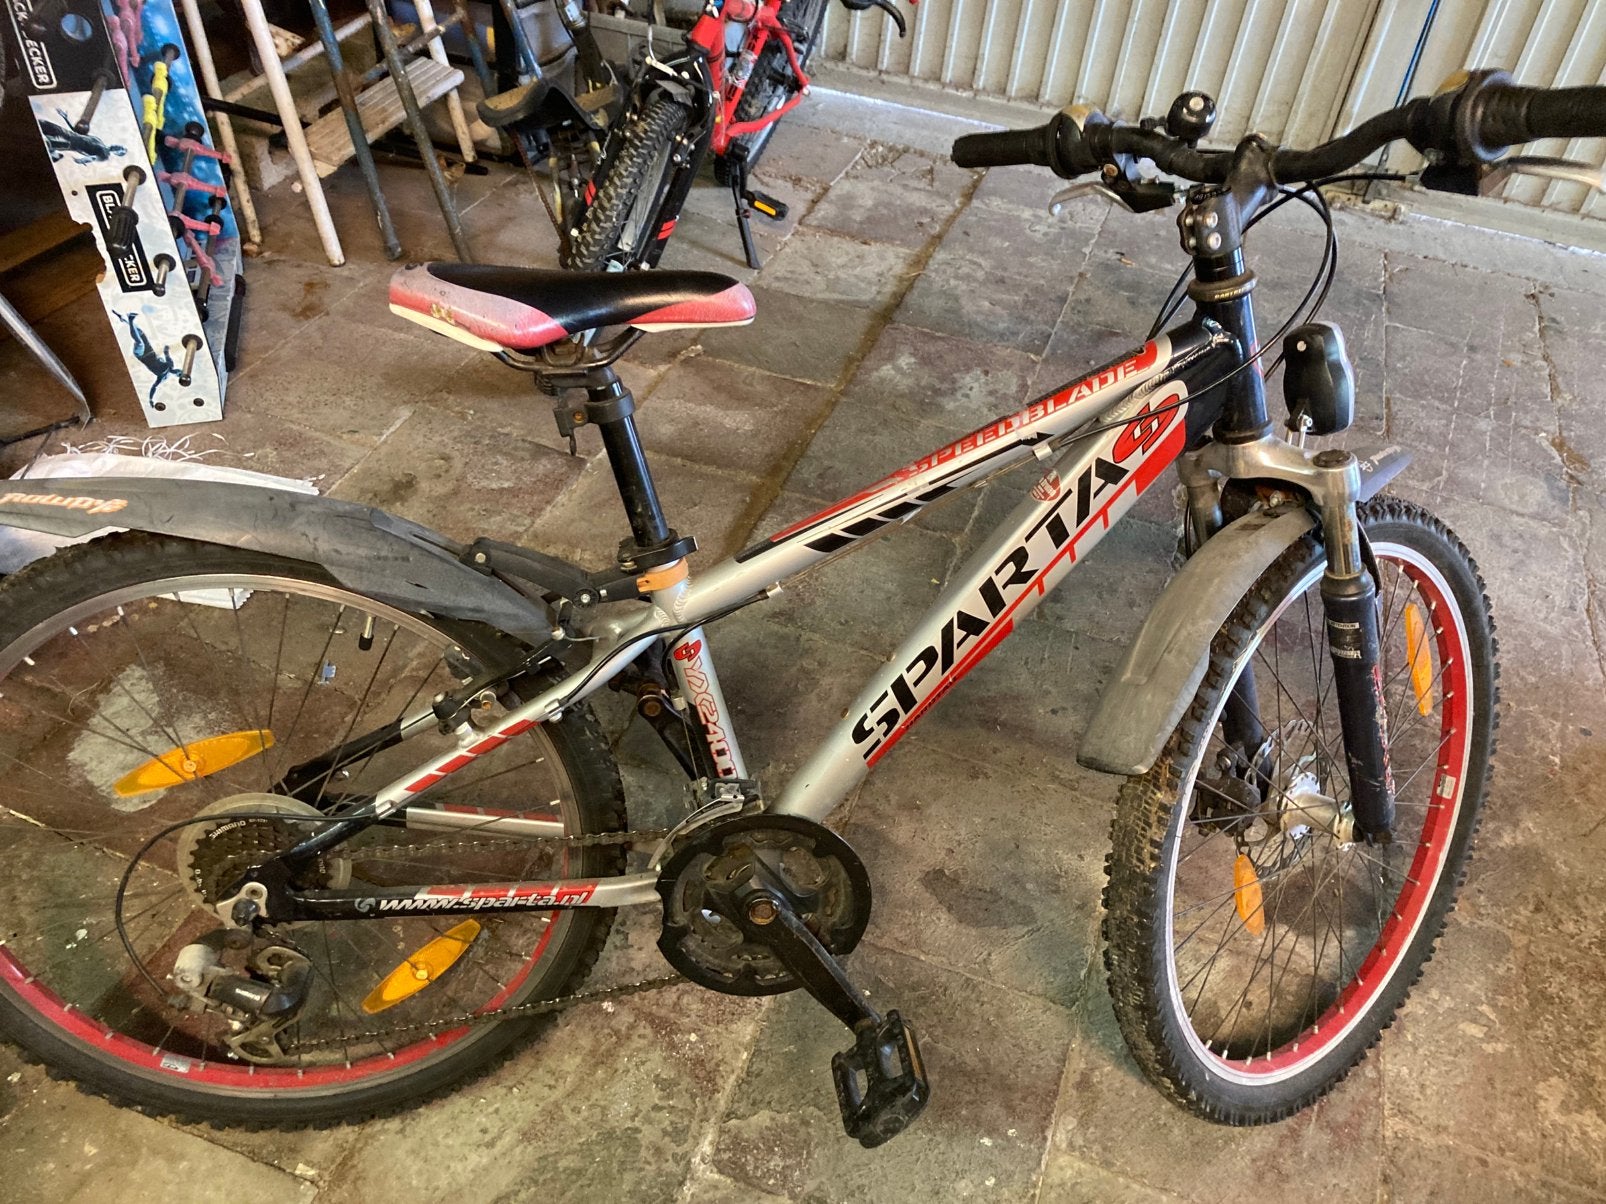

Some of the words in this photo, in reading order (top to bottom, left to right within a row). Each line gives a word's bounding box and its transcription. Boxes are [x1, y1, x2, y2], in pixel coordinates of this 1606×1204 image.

[22, 31, 51, 84] ECKER
[851, 460, 1130, 760] SPARTA
[208, 820, 247, 841] SHIMANO
[379, 890, 590, 911] www.sparta.nl
